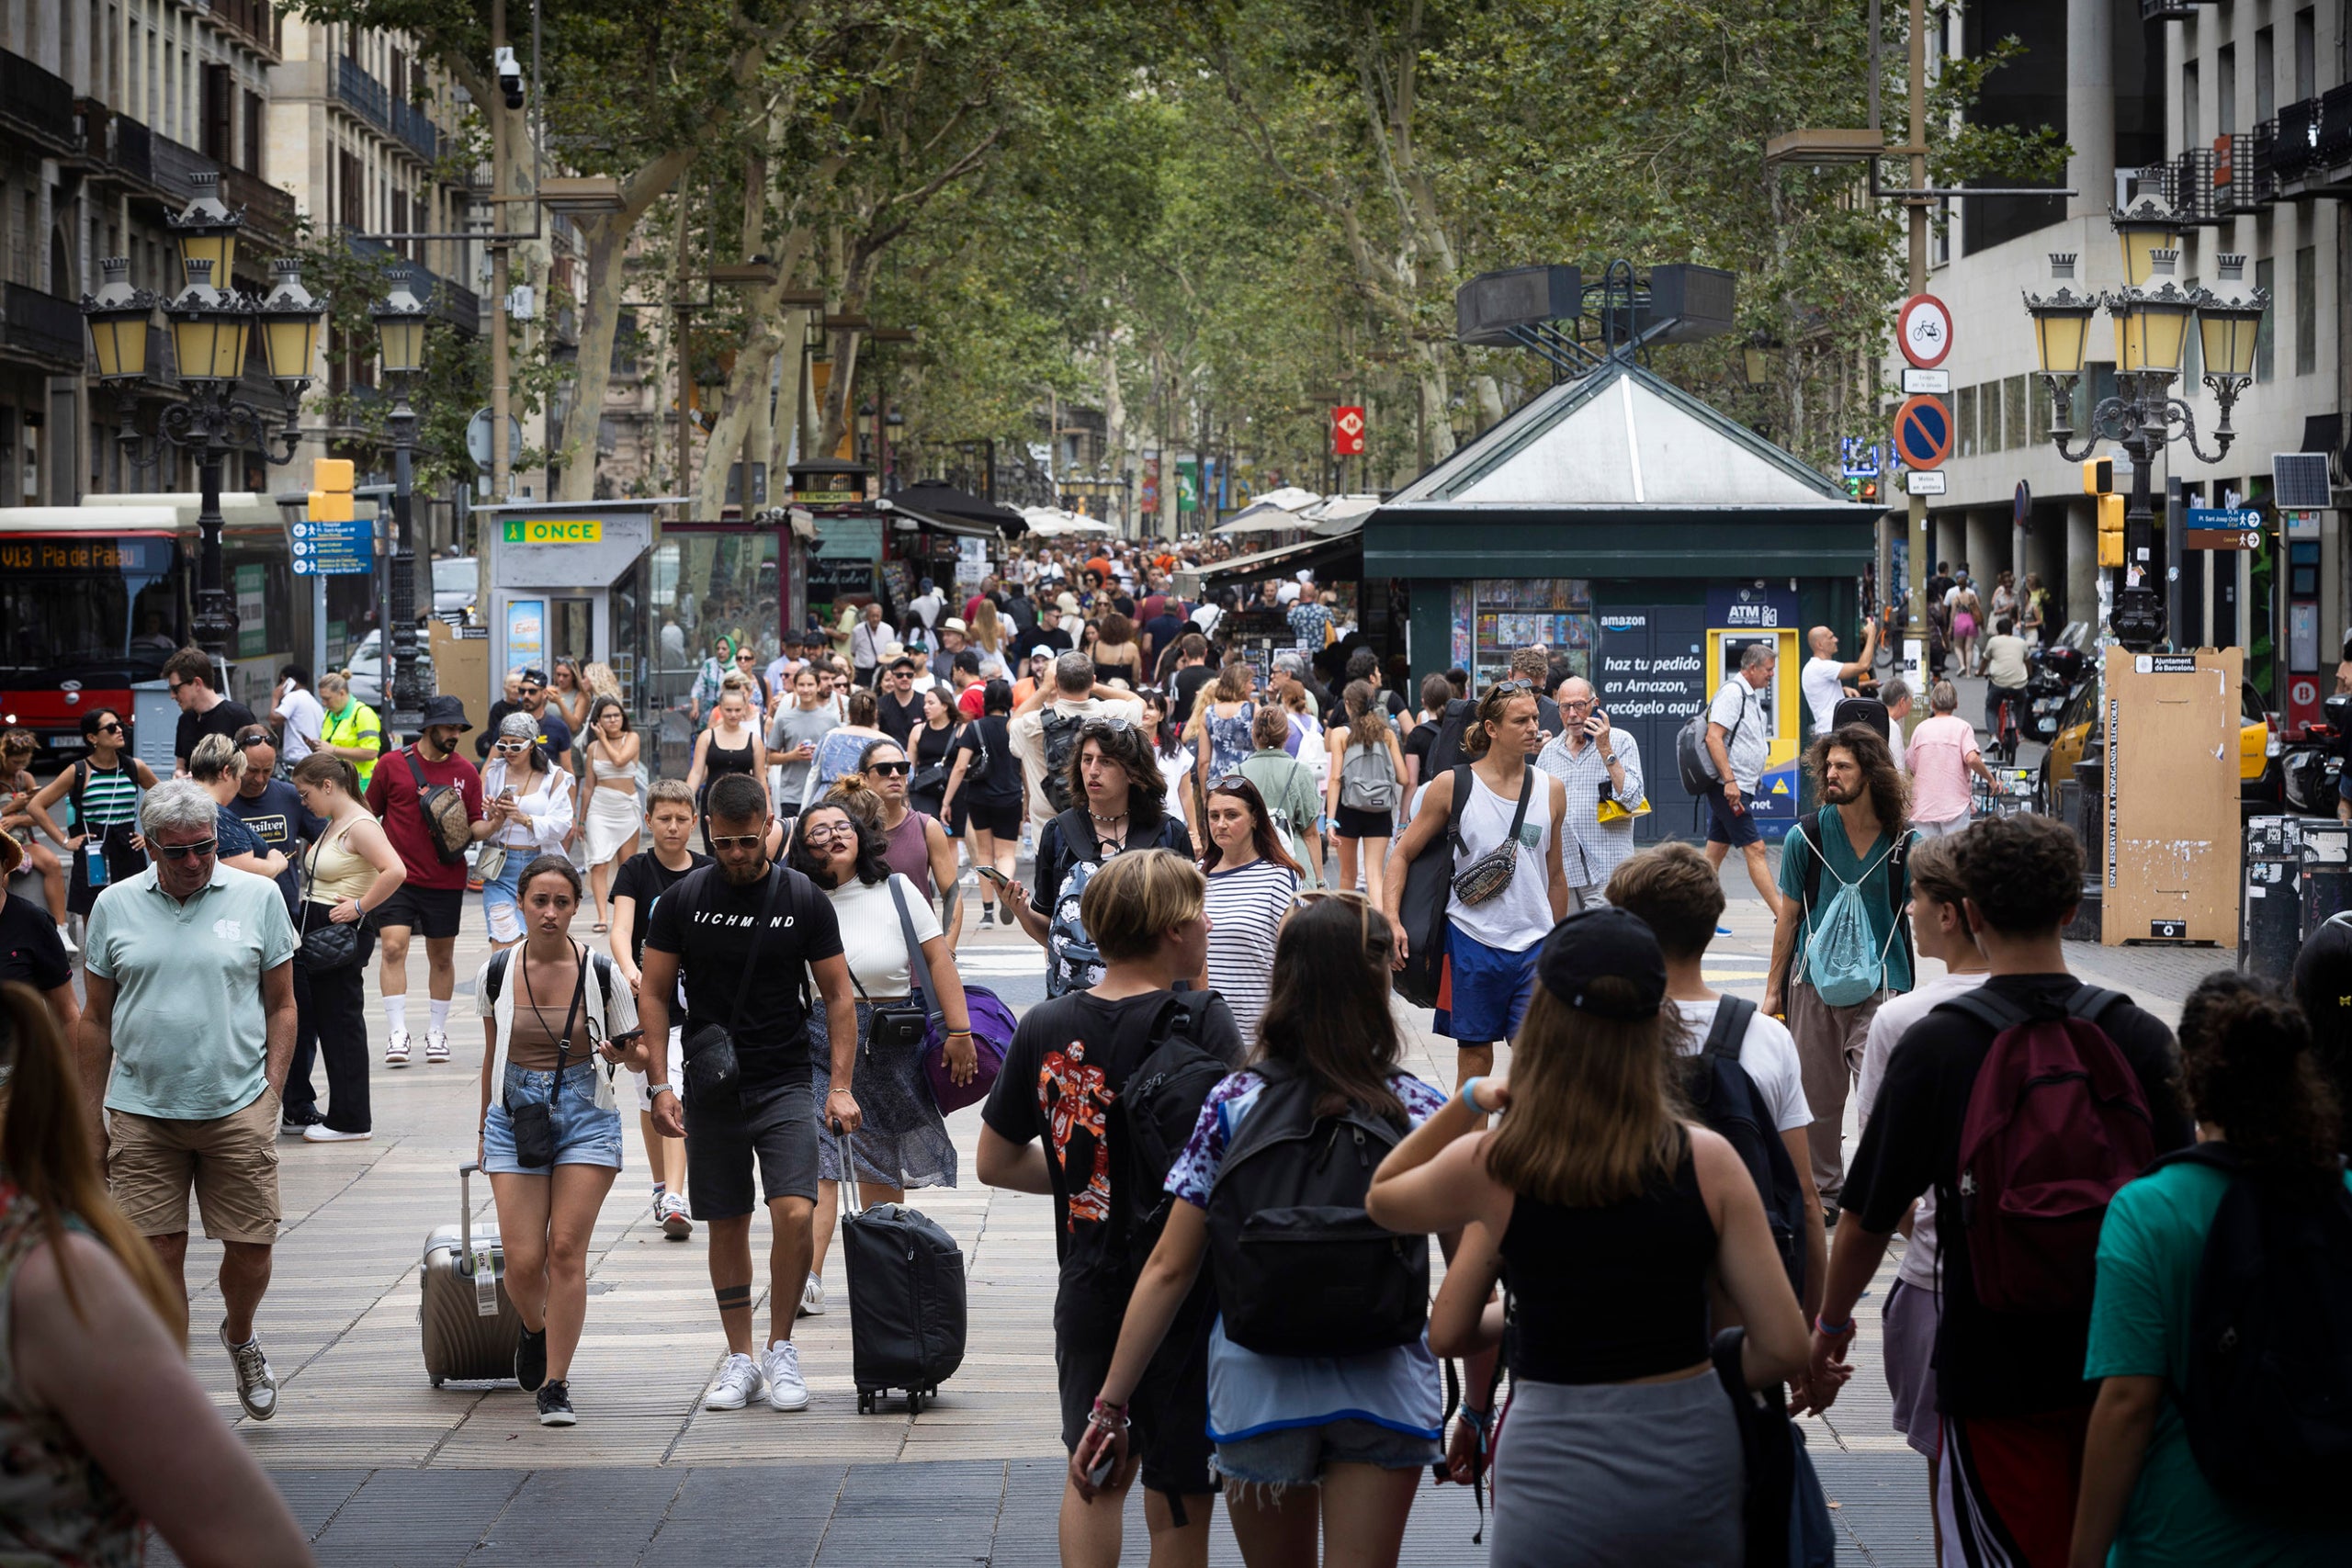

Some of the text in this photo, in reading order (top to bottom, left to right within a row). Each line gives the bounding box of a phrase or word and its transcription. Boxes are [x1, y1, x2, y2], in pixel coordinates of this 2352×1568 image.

[1347, 419, 1357, 429] M
[534, 524, 594, 539] ONCE
[1, 544, 134, 568] V13 Pla de Palau
[1729, 605, 1759, 617] ATM
[1600, 615, 1646, 626] amazon
[1604, 656, 1702, 674] haz tu pedido
[1604, 679, 1688, 695] en Amazon,
[2299, 686, 2311, 700] B
[1605, 699, 1702, 717] recógelo aquí
[2110, 699, 2119, 743] ELECTORAL
[694, 910, 795, 928] RICHMND
[212, 919, 241, 941] 45
[478, 1252, 486, 1268] BCN
